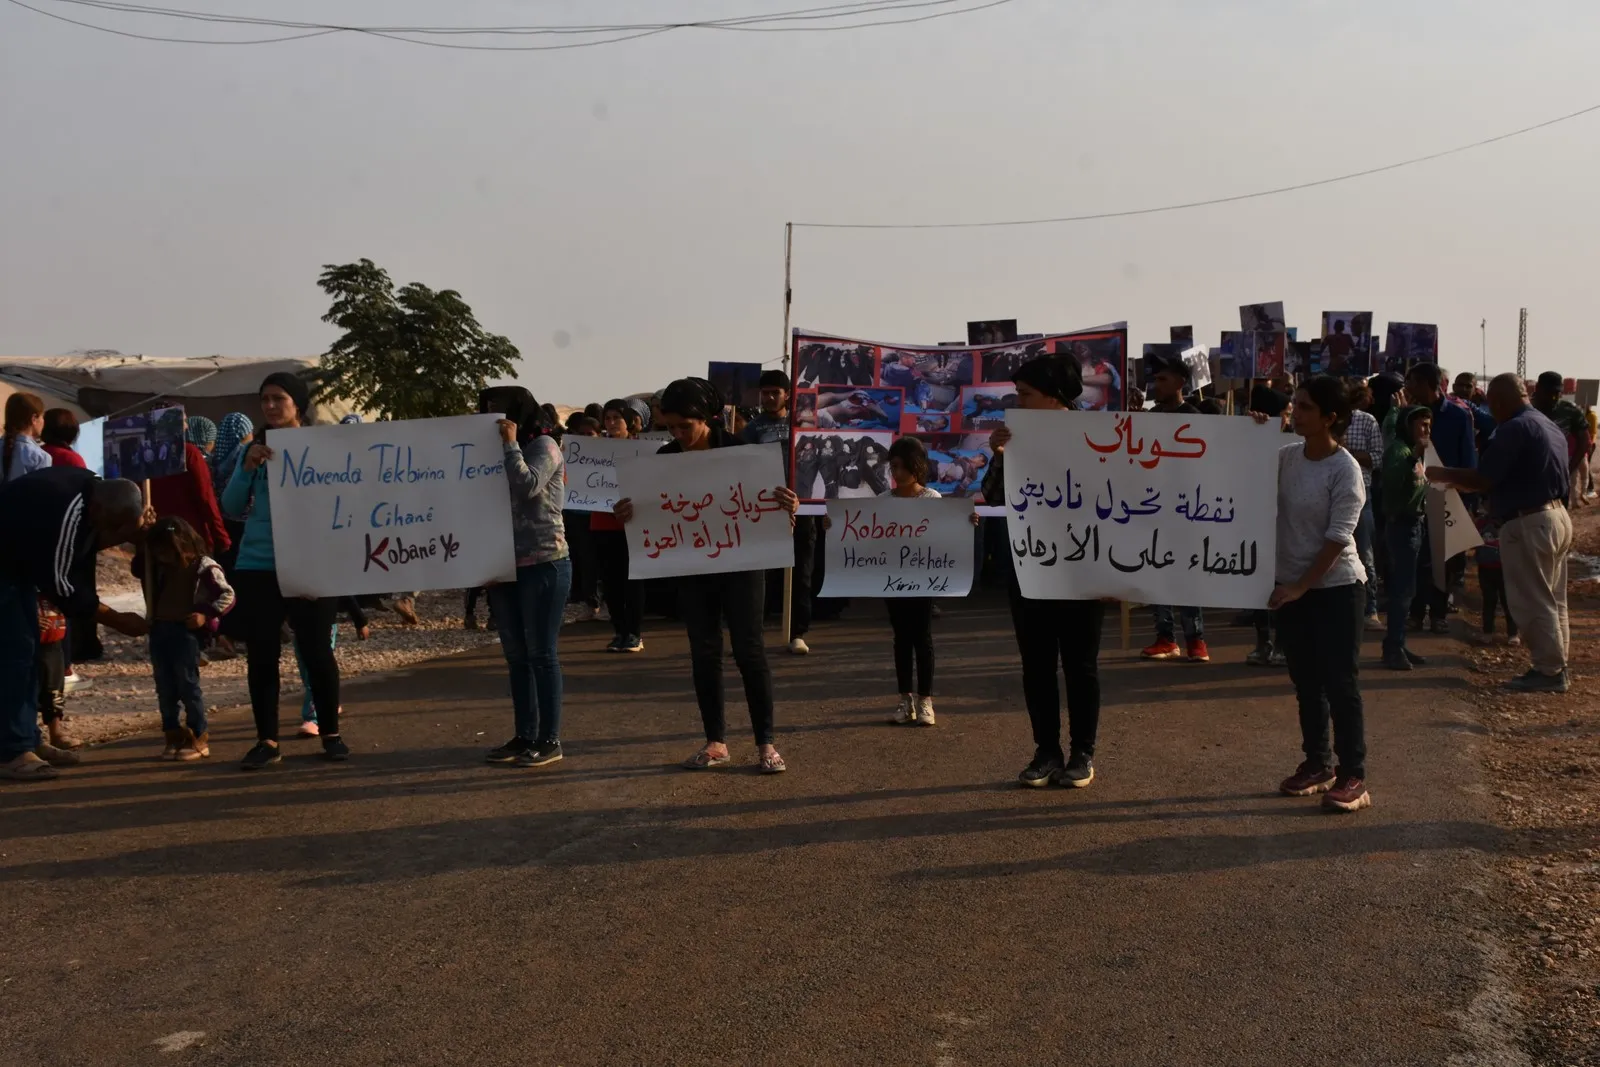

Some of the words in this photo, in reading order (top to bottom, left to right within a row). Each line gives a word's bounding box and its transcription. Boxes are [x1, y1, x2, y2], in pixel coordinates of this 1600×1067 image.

[566, 441, 617, 469] Berxwed
[1083, 412, 1208, 470] كوباني
[280, 445, 363, 488] Navenda
[331, 495, 353, 531] Li
[370, 501, 434, 530] Cihanê
[659, 491, 714, 522] صرخة
[719, 481, 782, 524] كوباني
[1008, 467, 1083, 521] تاريخي
[1095, 478, 1163, 525] تحول
[1174, 483, 1235, 523] نقطة
[642, 522, 684, 559] الحرة
[692, 520, 741, 559] المرأة
[840, 509, 930, 542] Kobanê
[843, 546, 888, 569] Hemû
[1107, 527, 1176, 574] على
[1187, 535, 1258, 577] للقضاء
[883, 575, 921, 593] Kirin
[927, 575, 949, 592] Yek
